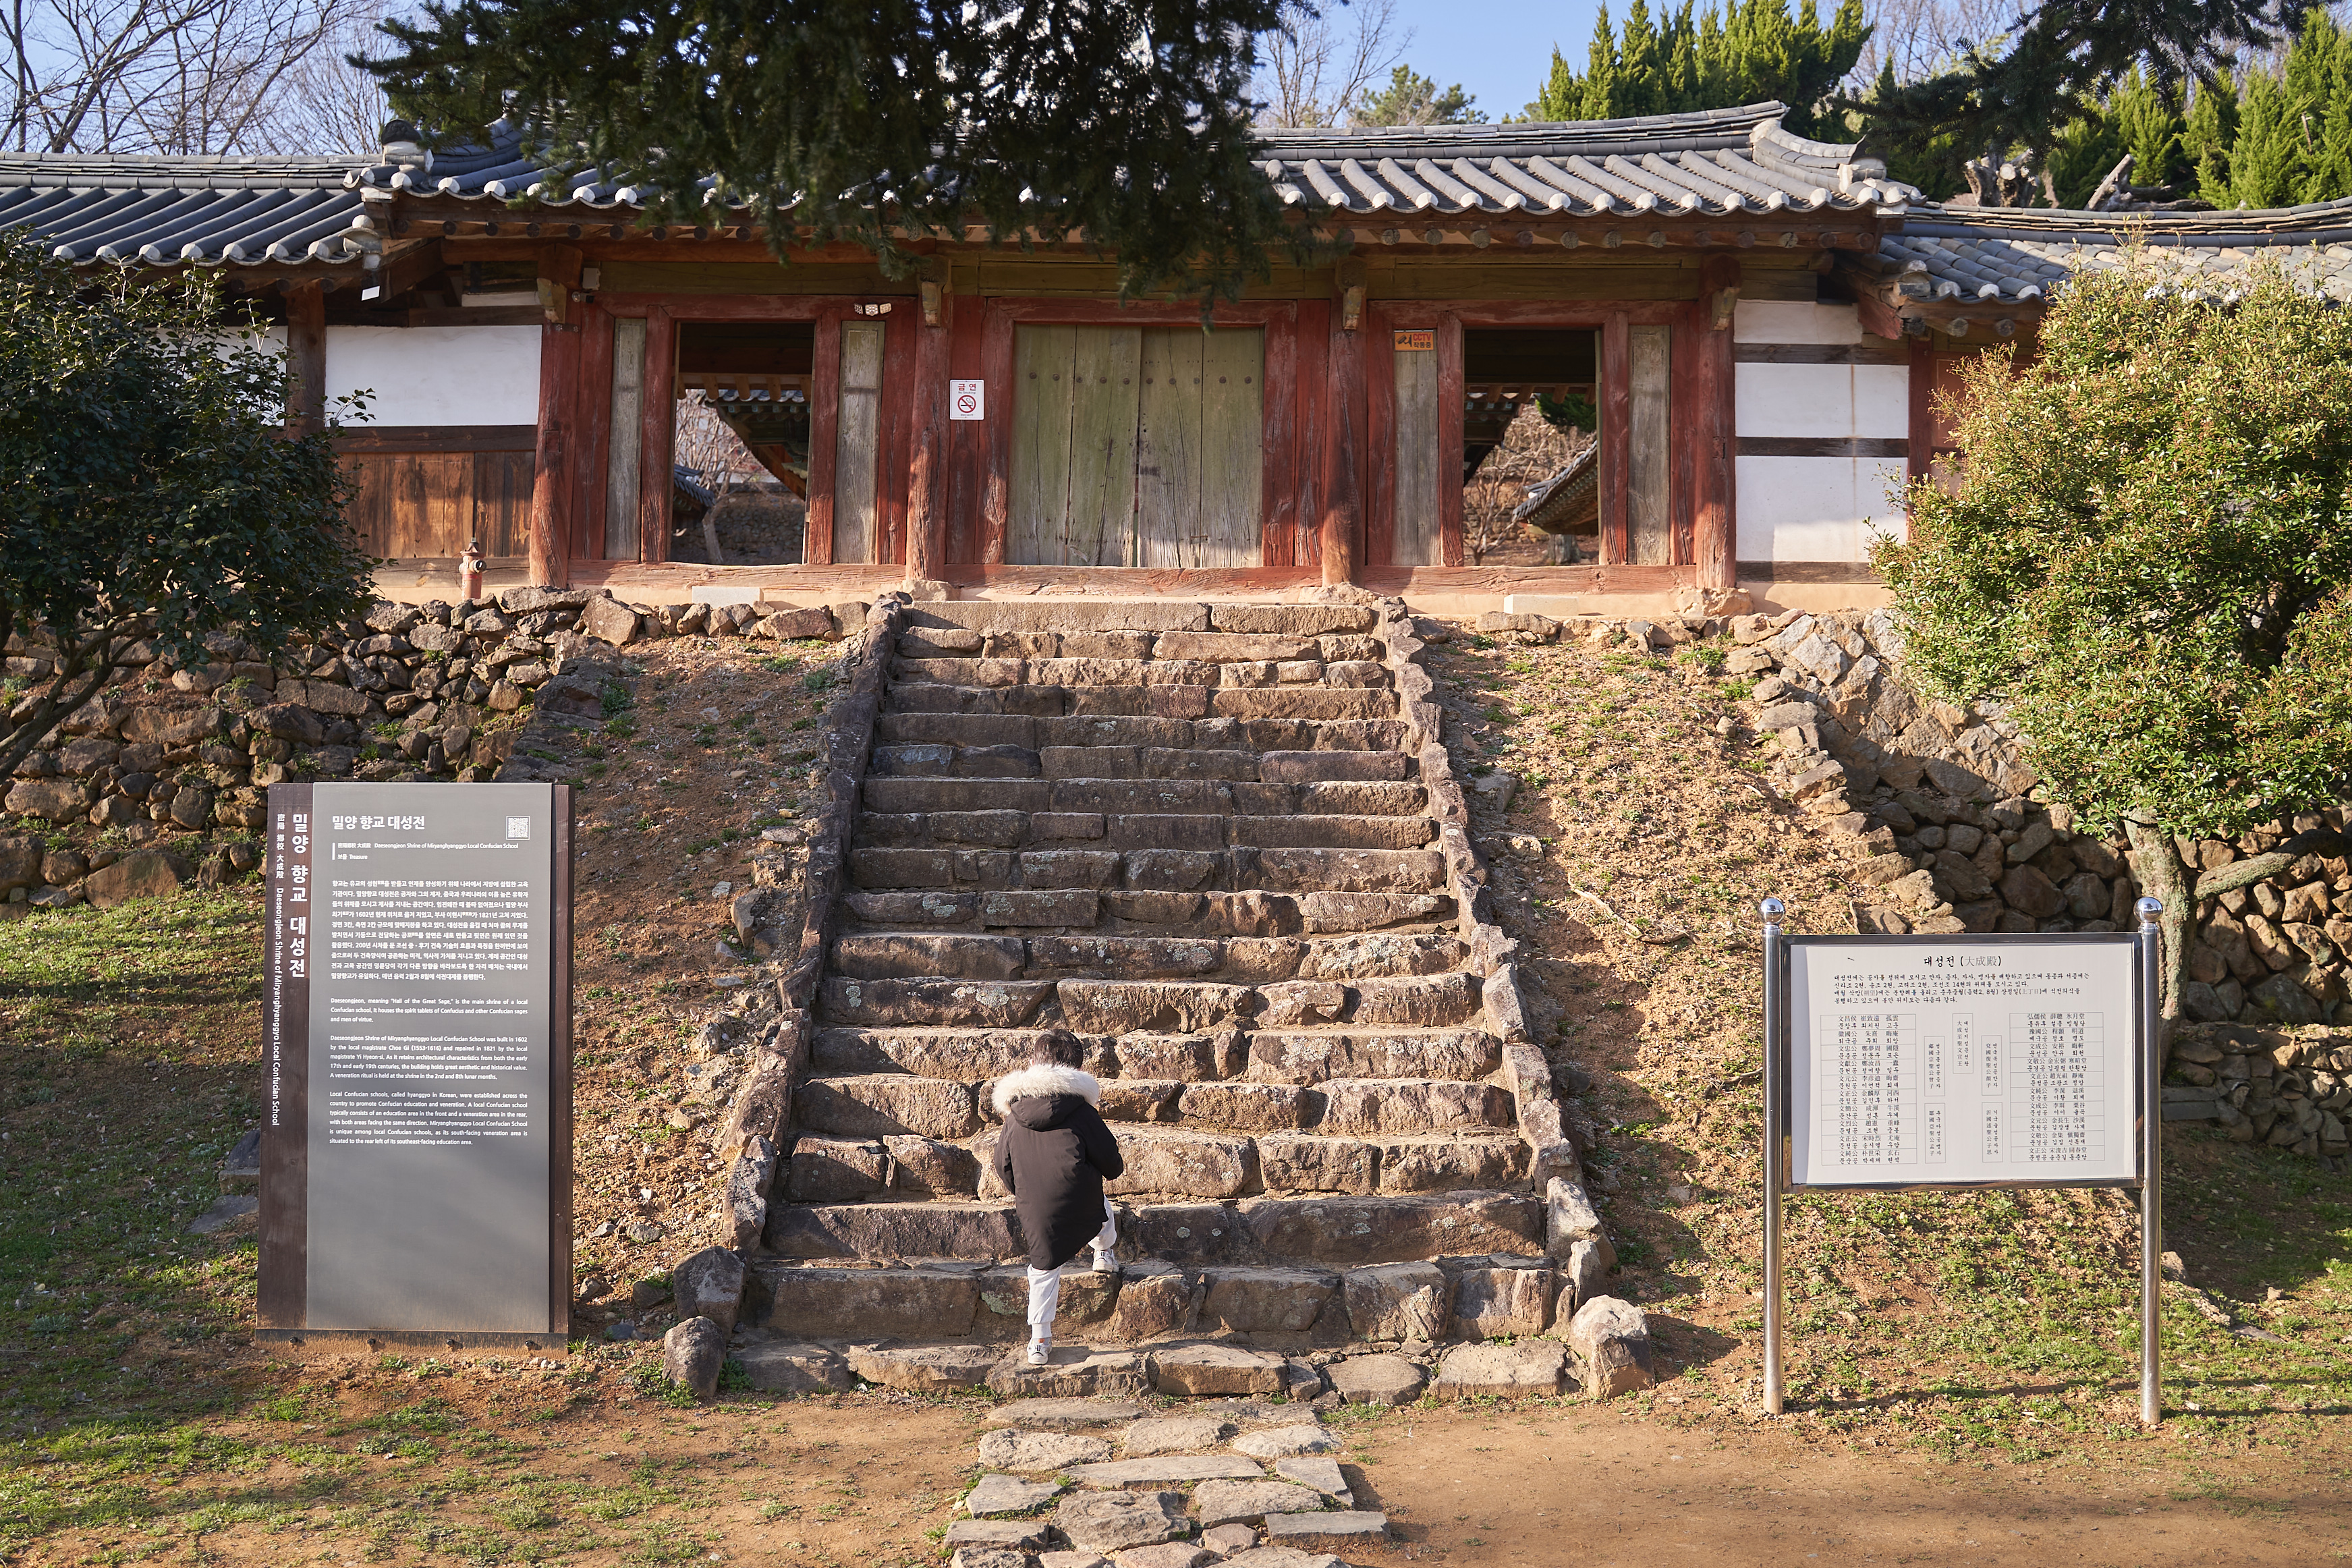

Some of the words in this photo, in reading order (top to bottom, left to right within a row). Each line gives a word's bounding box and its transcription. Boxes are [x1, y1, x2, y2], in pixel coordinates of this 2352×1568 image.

[291, 814, 309, 853] 밀양
[332, 815, 358, 830] 밀양
[360, 815, 385, 830] 향교
[388, 815, 425, 830] 대성전
[290, 864, 308, 902] 향교
[275, 887, 284, 940] Daeseongjeon
[275, 941, 283, 964] Shrine
[289, 916, 306, 978] 대성전
[1924, 955, 1954, 968] 대성전
[1960, 955, 2001, 967] (大成殿)
[274, 965, 283, 974] of
[273, 975, 282, 1040] Miryanghyanggyo
[273, 1042, 281, 1061] Local
[273, 1061, 281, 1100] Confucian
[272, 1100, 280, 1125] School
